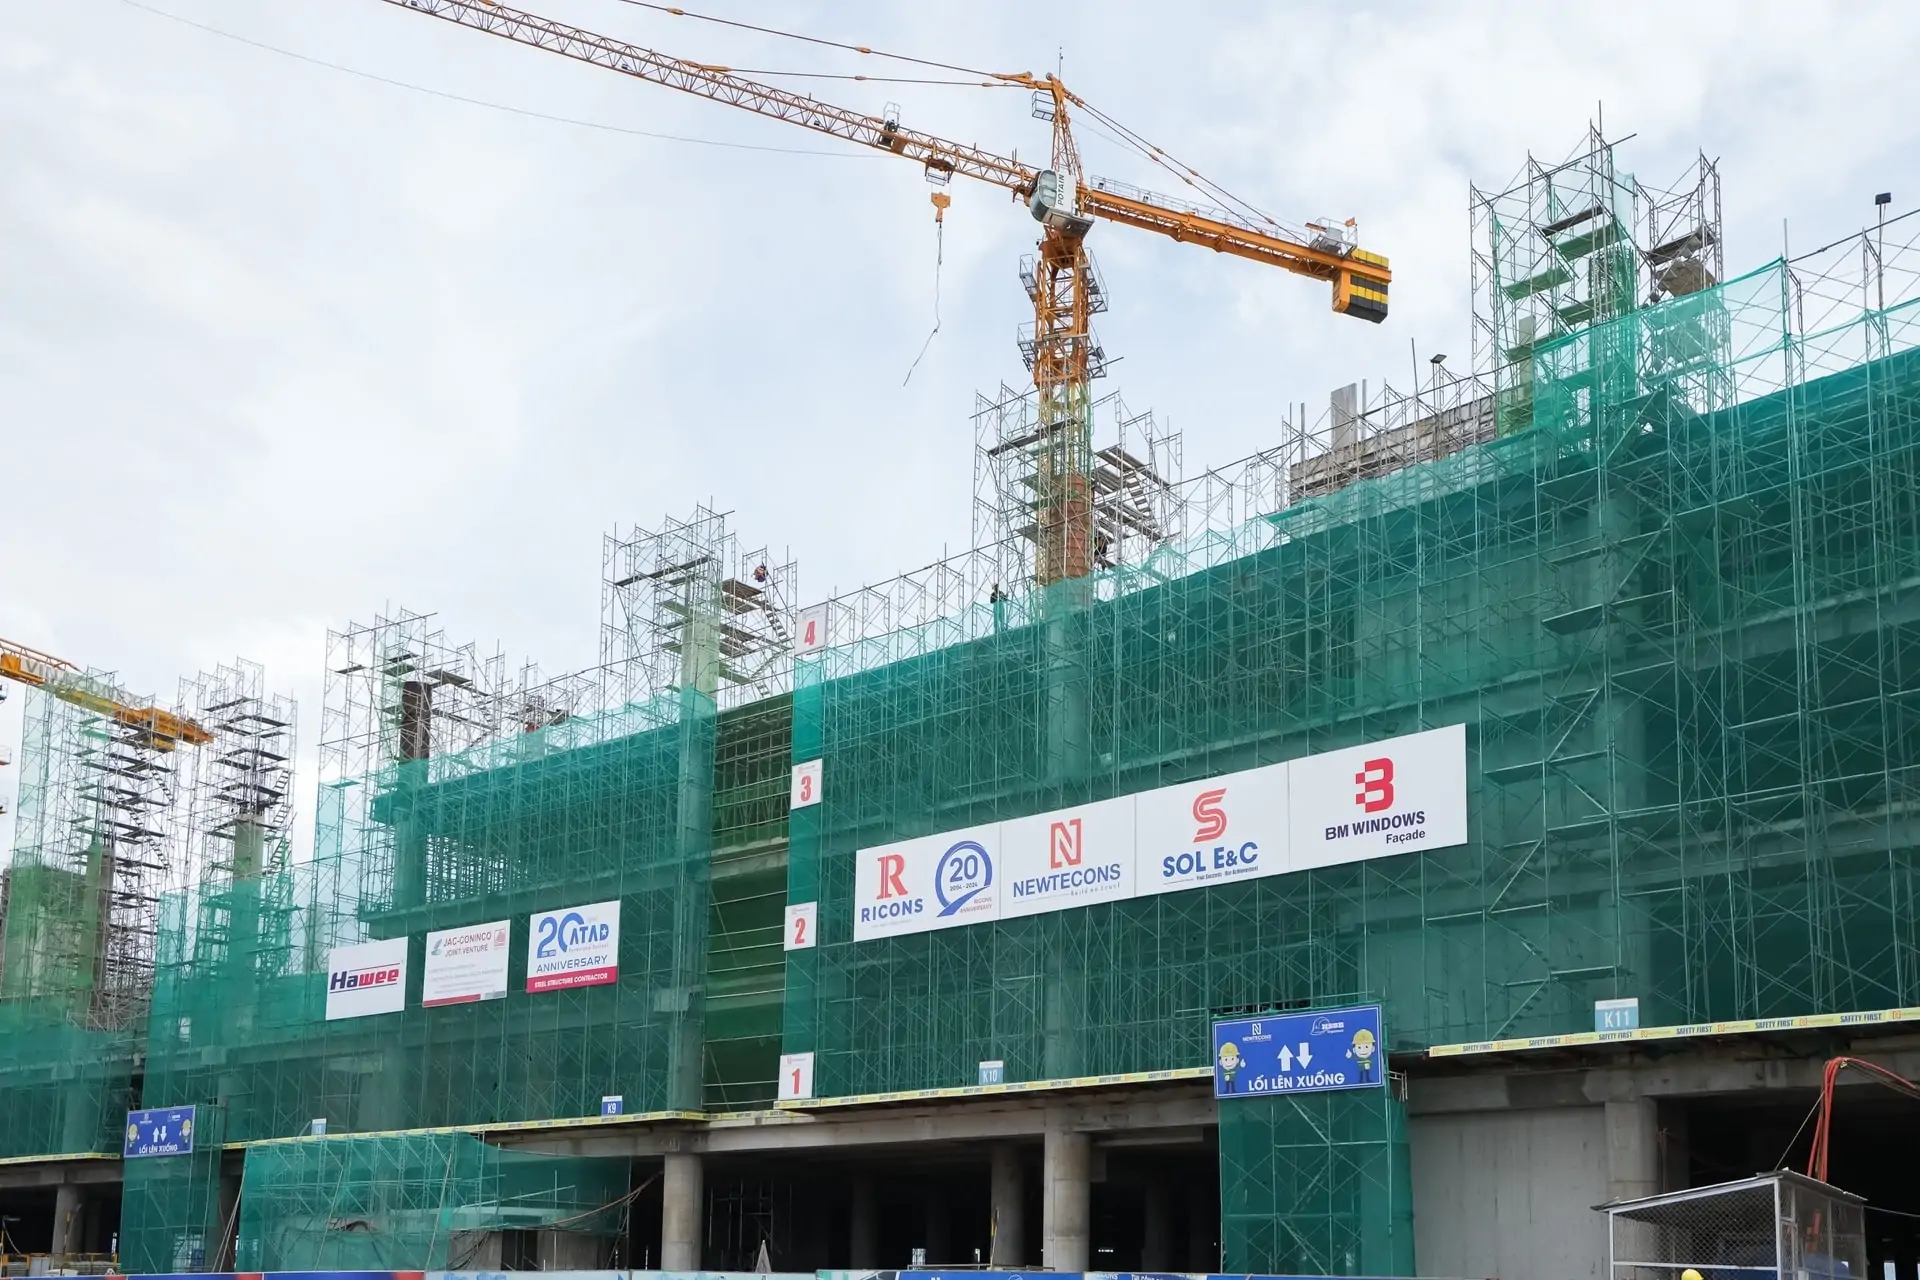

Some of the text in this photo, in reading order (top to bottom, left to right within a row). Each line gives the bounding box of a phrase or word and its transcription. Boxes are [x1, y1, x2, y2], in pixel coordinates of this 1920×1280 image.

[1057, 174, 1065, 206] POTAIN
[804, 620, 816, 646] 4
[801, 775, 812, 802] 3
[1325, 810, 1426, 841] BM WINDOWS
[1386, 829, 1426, 844] Façade
[949, 854, 979, 883] 20
[1163, 841, 1258, 877] SOL E&C
[1013, 863, 1121, 898] NEWTECONS
[861, 898, 924, 923] RICONS
[569, 923, 609, 946] ATAD
[794, 917, 806, 944] 2
[462, 943, 488, 955] VENTURE
[536, 954, 608, 974] ANNIVERSARY
[330, 968, 400, 991] Hawee
[573, 972, 608, 983] CONTRACTOR
[1604, 1010, 1631, 1029] K11
[1840, 1014, 1862, 1023] SAFETY
[1863, 1012, 1882, 1022] FIRST
[791, 1067, 800, 1095] 1
[983, 1069, 998, 1083] K10
[1248, 1069, 1345, 1091] LỐI LÊN XUỐNG
